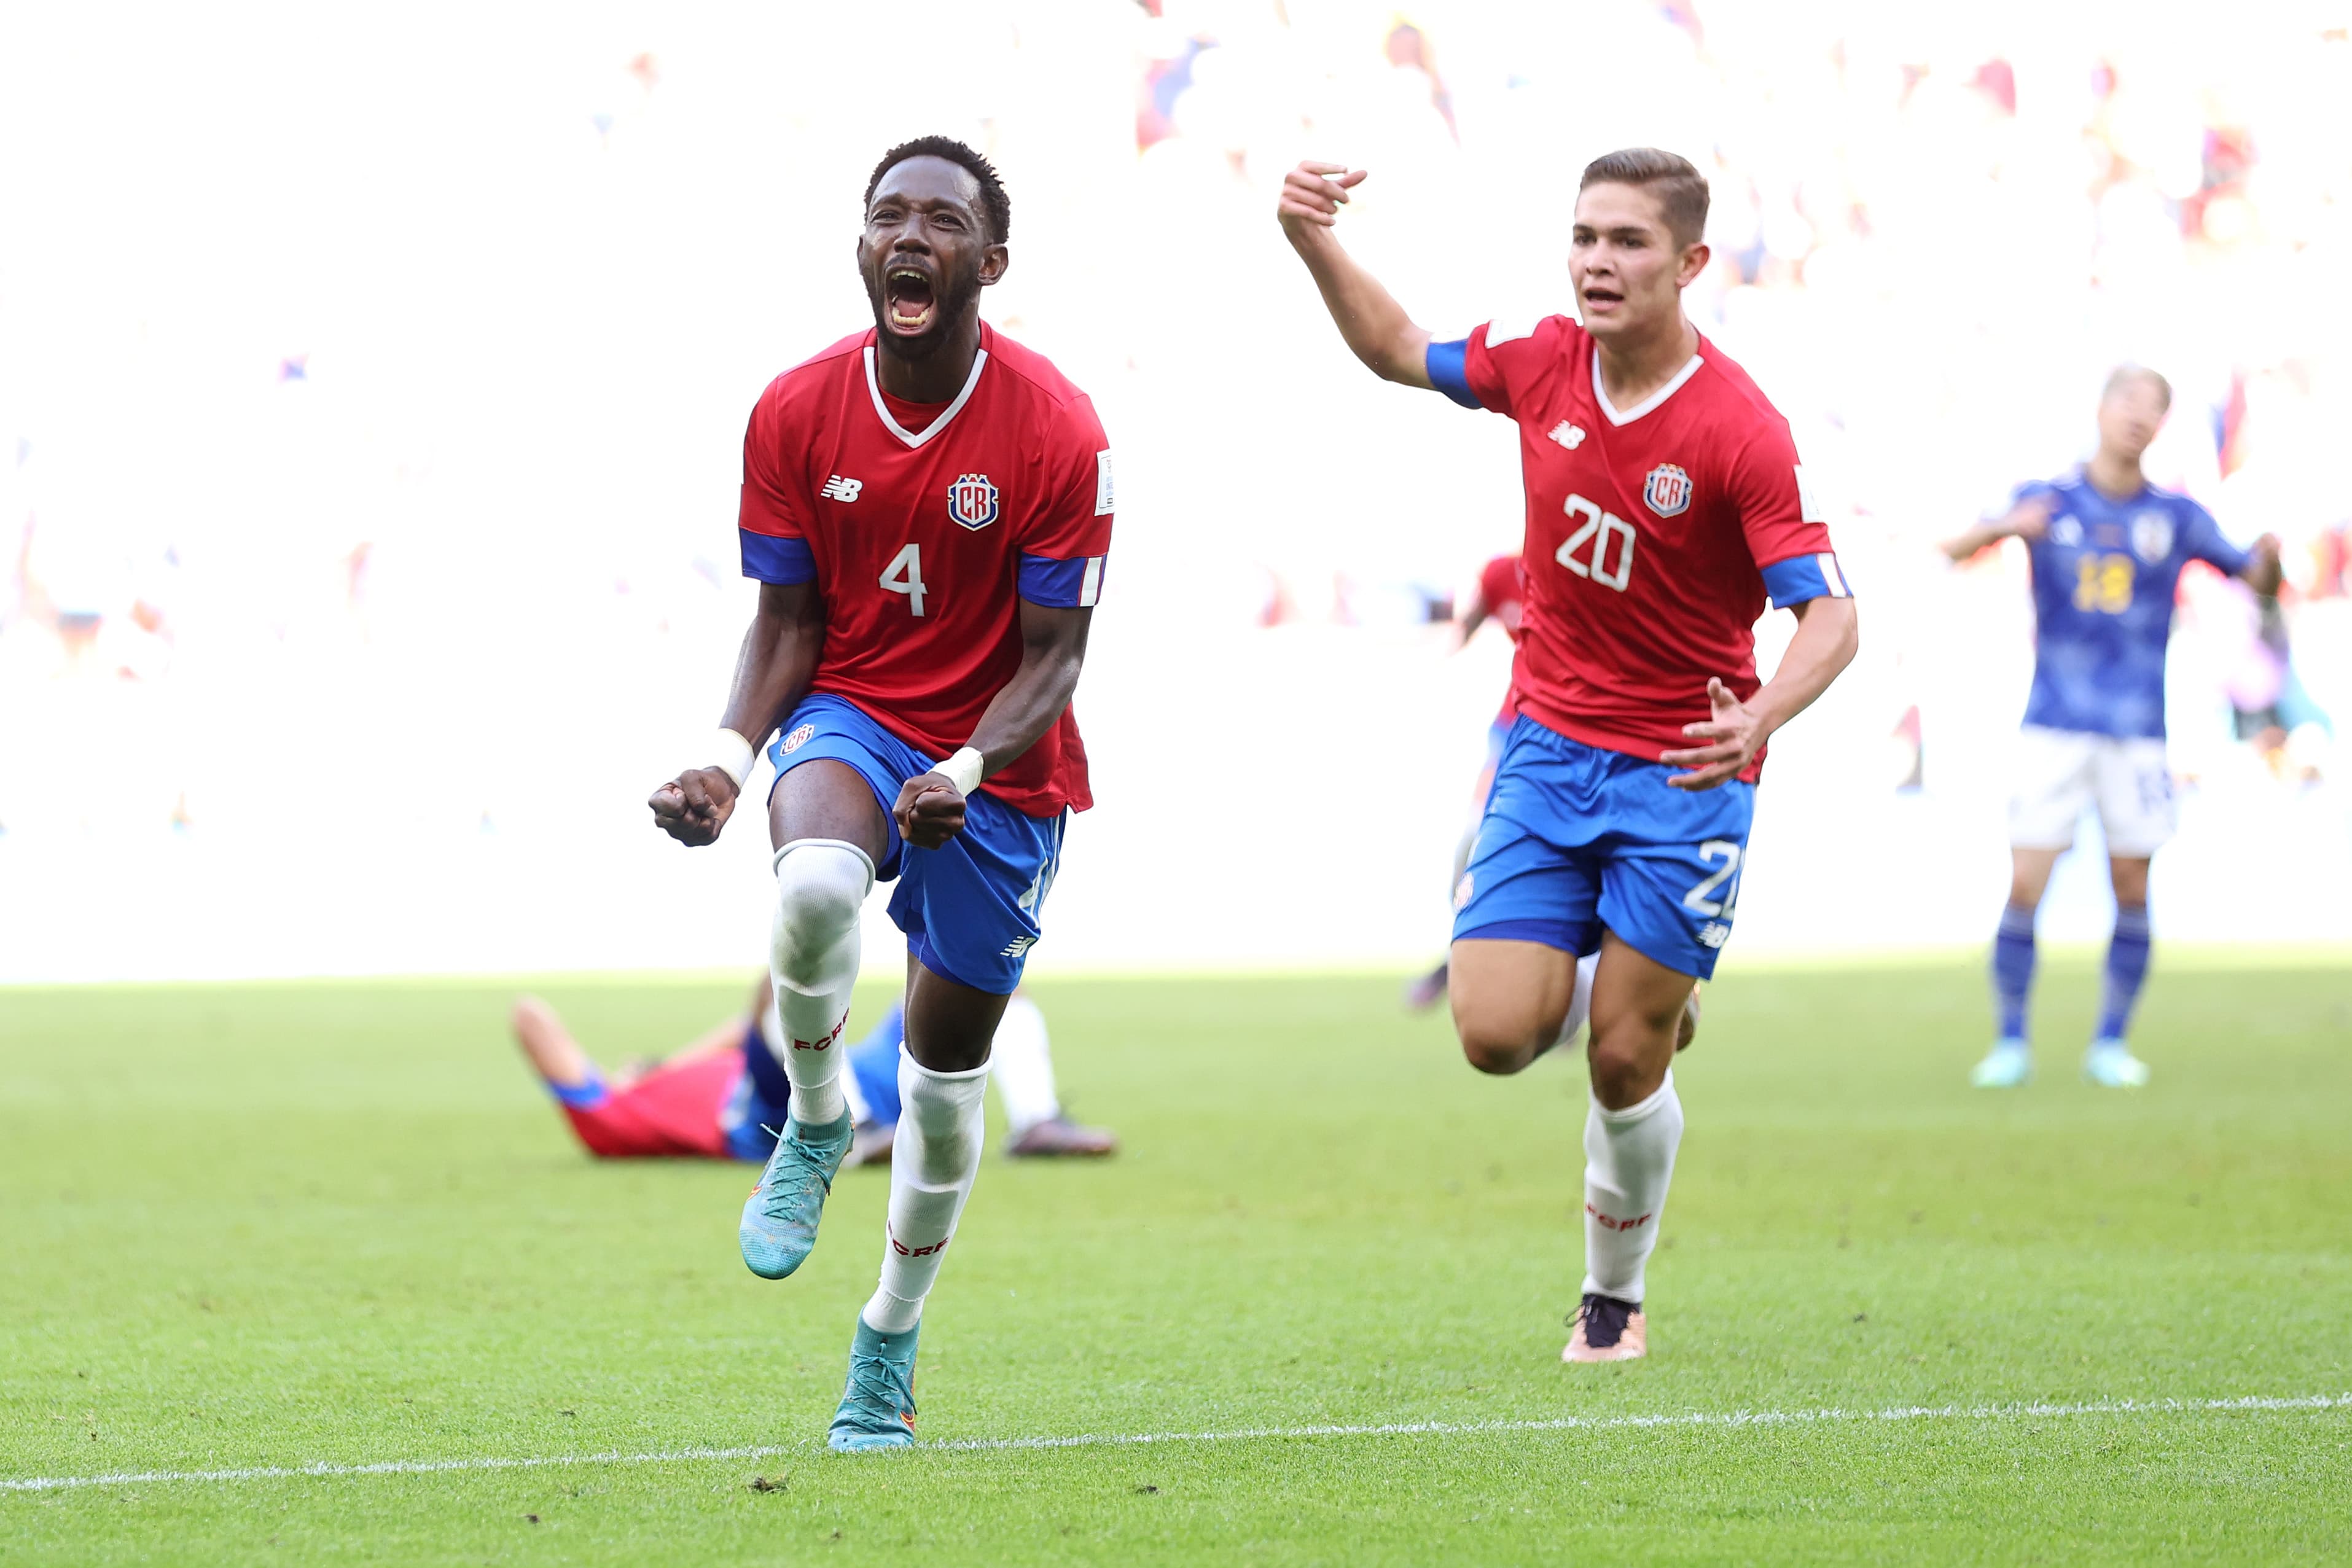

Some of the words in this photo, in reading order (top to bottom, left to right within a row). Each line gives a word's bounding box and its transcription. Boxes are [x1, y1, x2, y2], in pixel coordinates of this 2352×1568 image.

[959, 486, 987, 520] CR
[1555, 493, 1636, 592] 20
[879, 544, 928, 617] 4
[888, 1219, 948, 1257] CRF
